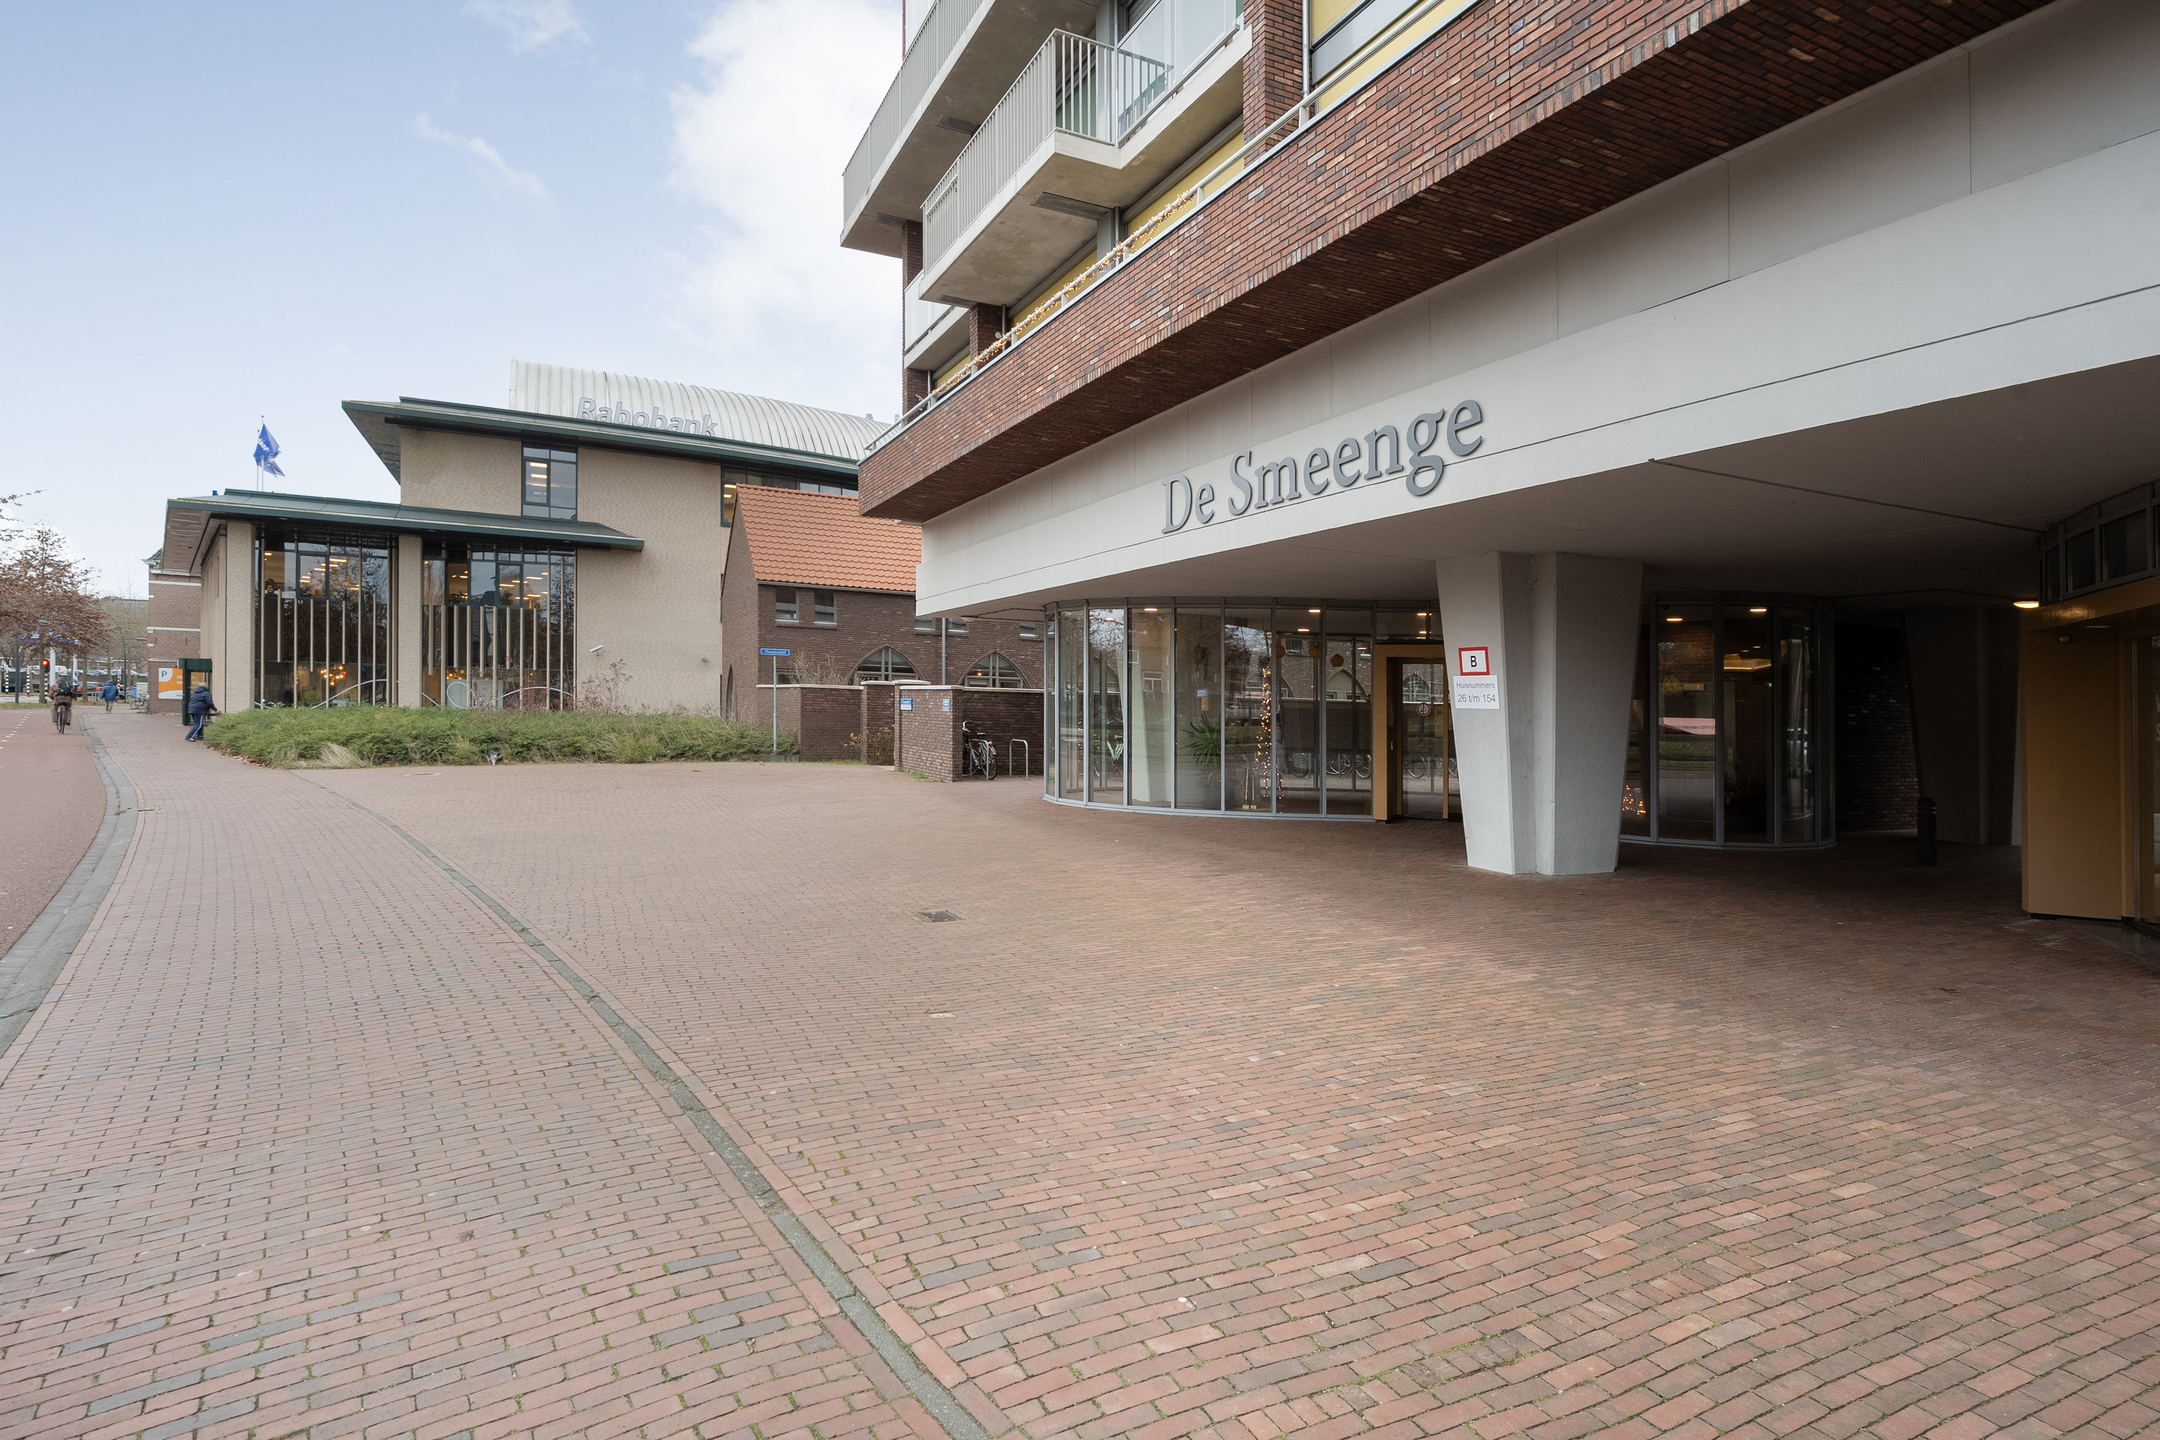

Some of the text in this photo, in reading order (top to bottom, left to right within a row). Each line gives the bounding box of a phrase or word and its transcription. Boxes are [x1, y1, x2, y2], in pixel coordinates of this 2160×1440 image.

[576, 396, 718, 437] Rabobank
[1161, 399, 1483, 534] De Smeenge
[1470, 655, 1477, 667] B
[1457, 694, 1496, 703] 26 t/m 154
